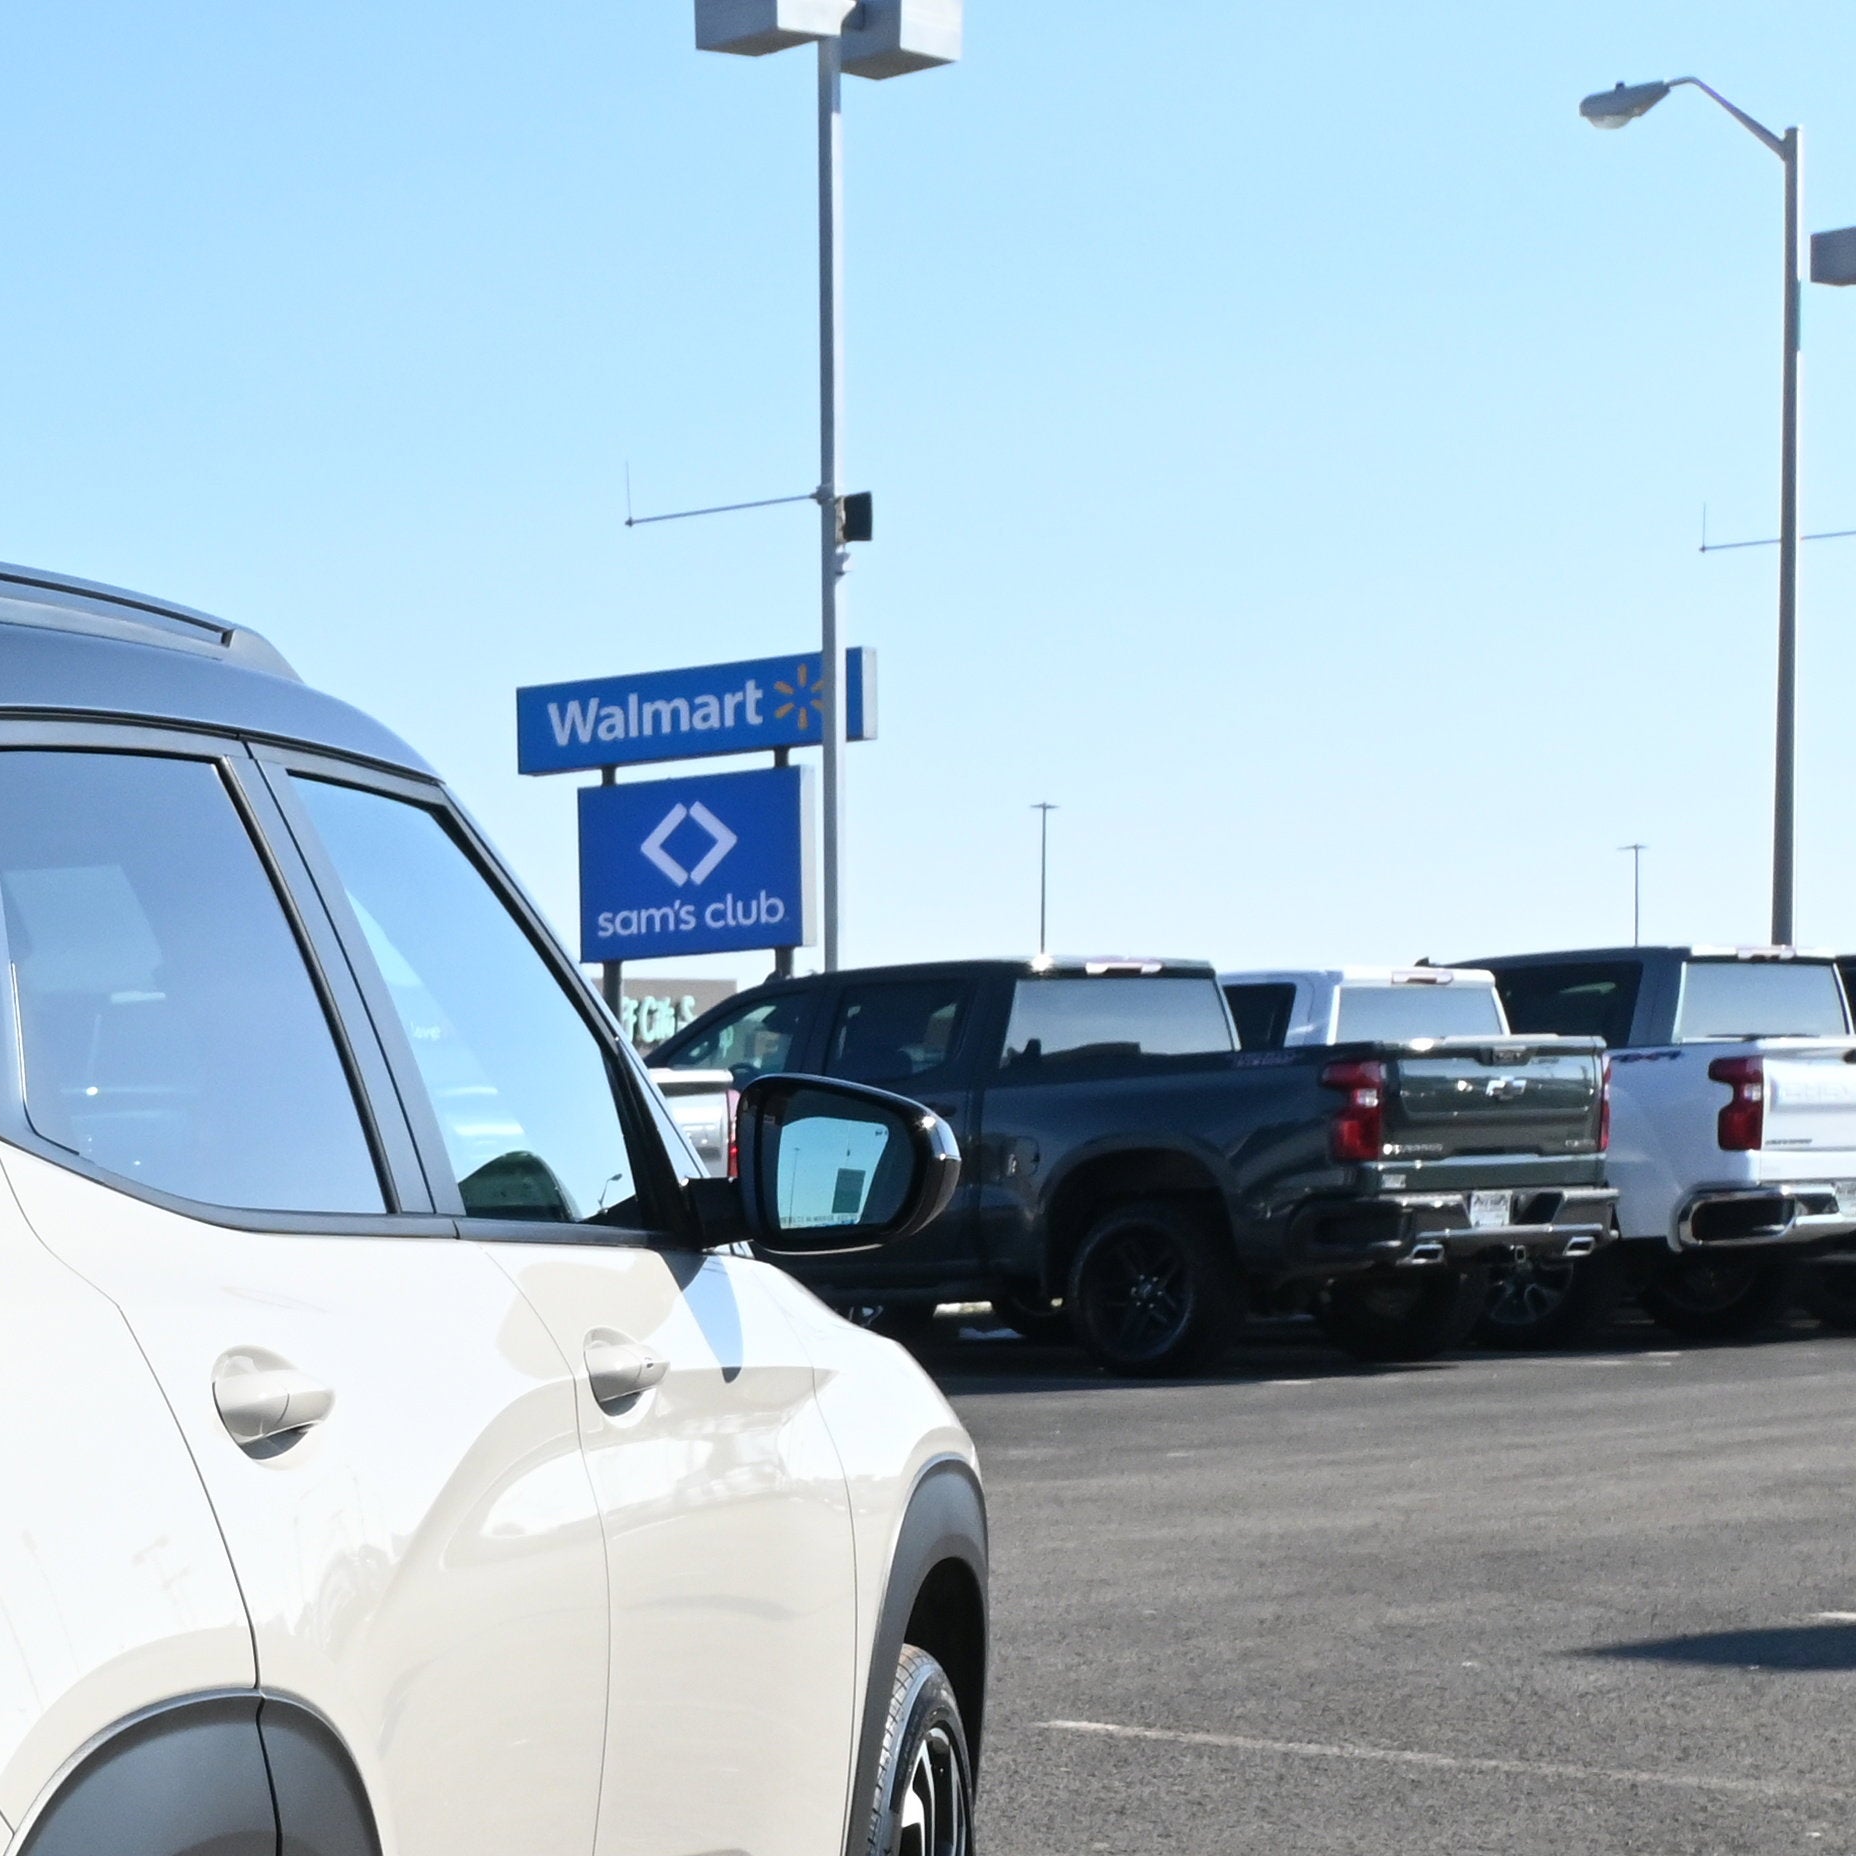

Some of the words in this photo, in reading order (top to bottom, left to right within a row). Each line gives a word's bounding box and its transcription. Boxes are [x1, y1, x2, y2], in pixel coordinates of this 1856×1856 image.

[547, 679, 764, 748] Walmart
[597, 901, 696, 938] sam's
[704, 889, 786, 929] club
